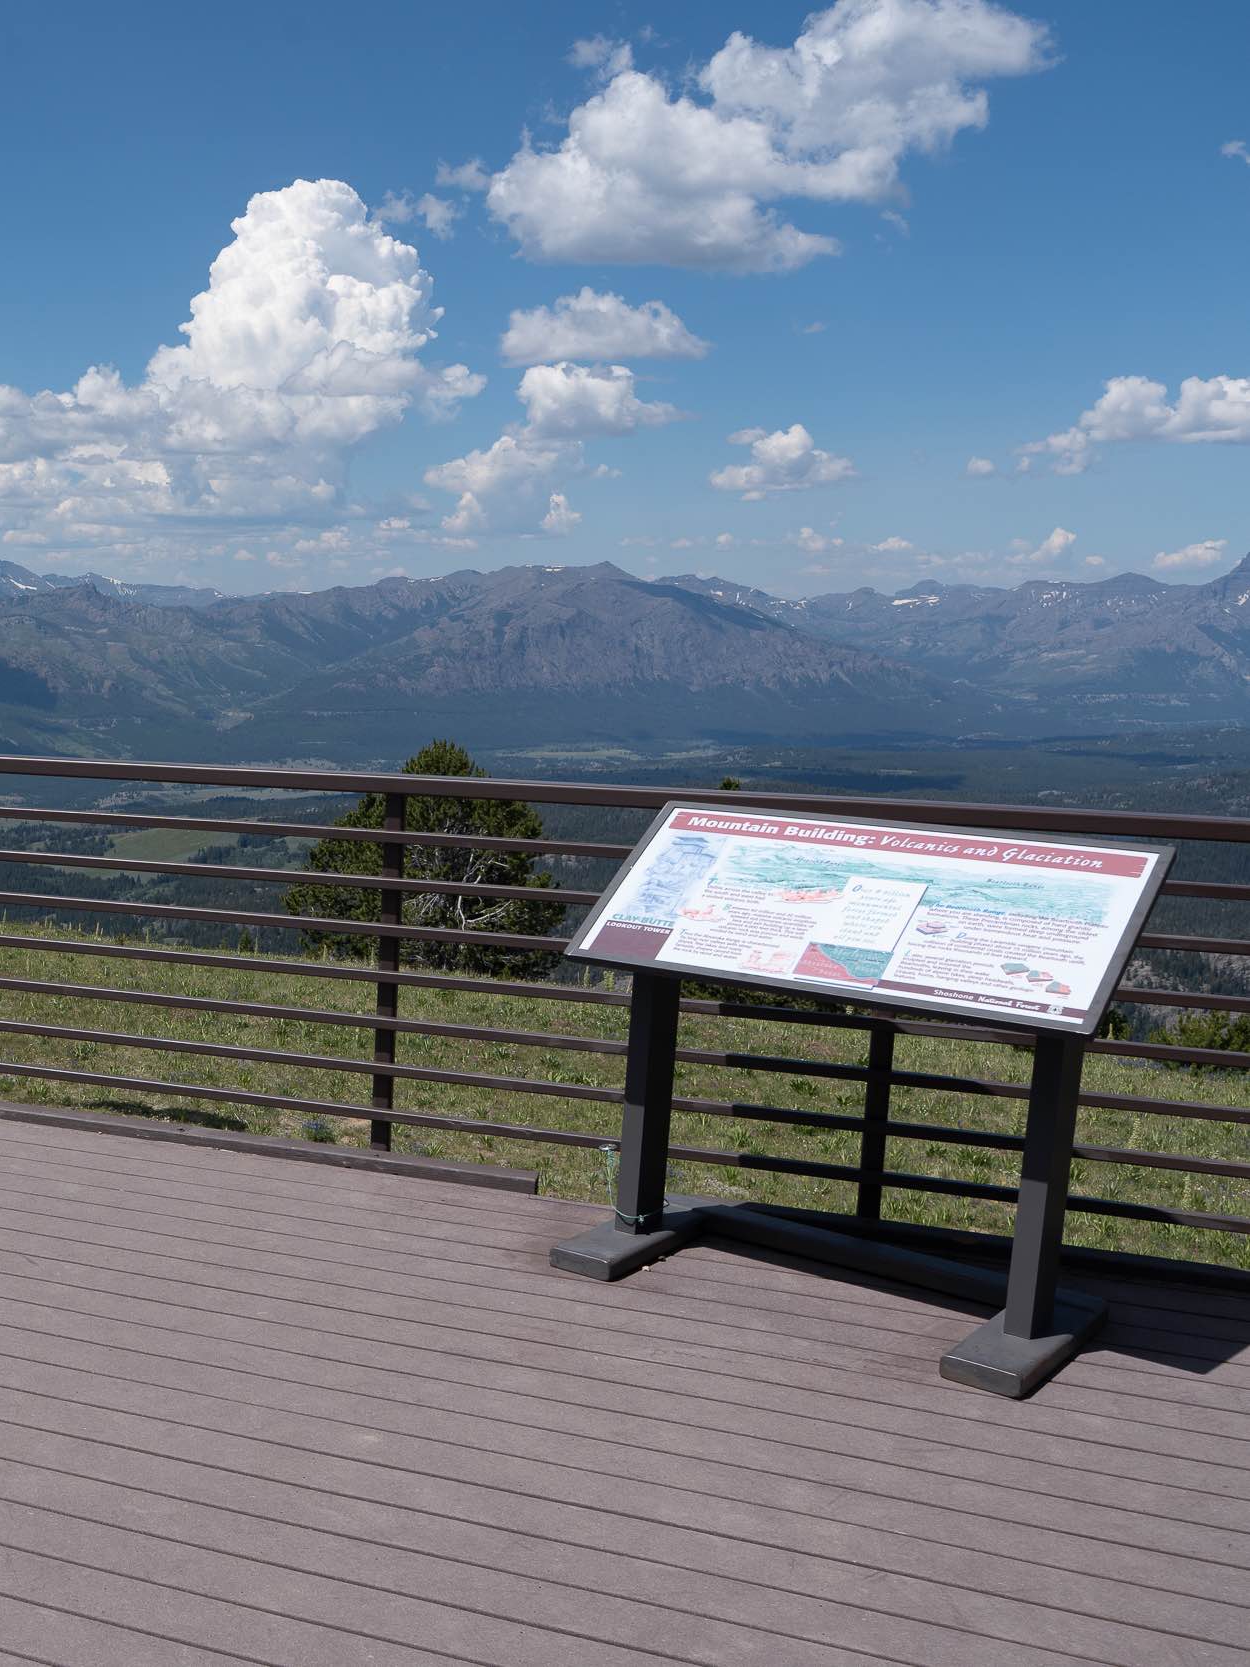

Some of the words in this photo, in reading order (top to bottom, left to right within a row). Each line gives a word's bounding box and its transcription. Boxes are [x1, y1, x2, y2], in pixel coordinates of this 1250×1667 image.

[687, 816, 780, 835] Mountain
[783, 826, 877, 846] Building:
[880, 836, 959, 854] Volcanics
[963, 844, 998, 857] and
[1002, 848, 1103, 868] Glaciation
[606, 921, 643, 930] LOOKOUT
[644, 926, 671, 935] TOWER
[612, 913, 639, 922] CLAY
[640, 917, 675, 928] BUTTE
[933, 989, 974, 1000] Shoshone
[978, 995, 1013, 1007] National
